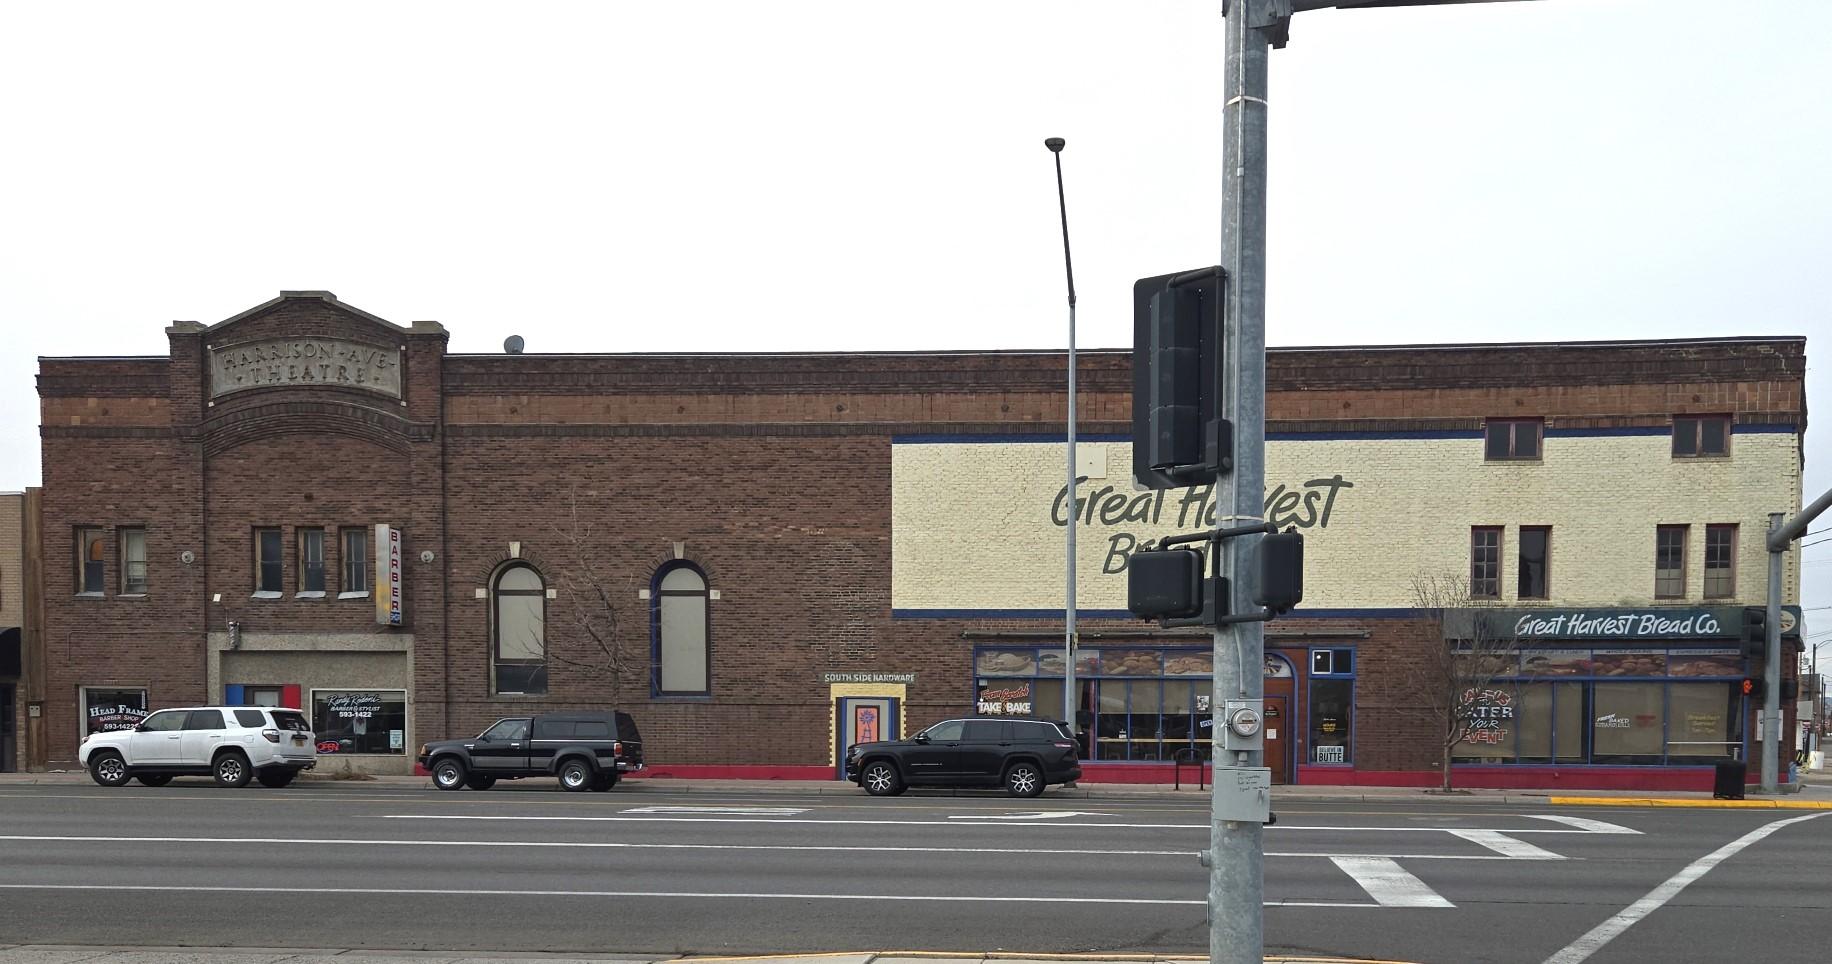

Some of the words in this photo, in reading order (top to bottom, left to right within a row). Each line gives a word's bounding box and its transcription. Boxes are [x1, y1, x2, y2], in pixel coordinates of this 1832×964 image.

[223, 343, 334, 369] HARRISON
[250, 364, 366, 384] THEATRE
[391, 531, 399, 610] BARBER
[1514, 613, 1566, 635] Great
[1567, 613, 1639, 635] Harvest
[1638, 614, 1694, 635] Bread
[1695, 613, 1720, 634] Co.
[824, 673, 852, 682] SOUTH
[853, 673, 872, 682] SIDE
[873, 673, 915, 682] HARDWARE
[89, 706, 116, 717] HEAD
[977, 702, 1002, 714] TAKE
[1007, 702, 1032, 714] BAKE
[1469, 718, 1500, 729] YOUR
[1460, 728, 1508, 744] EVENT
[1319, 752, 1343, 762] BUTTE
